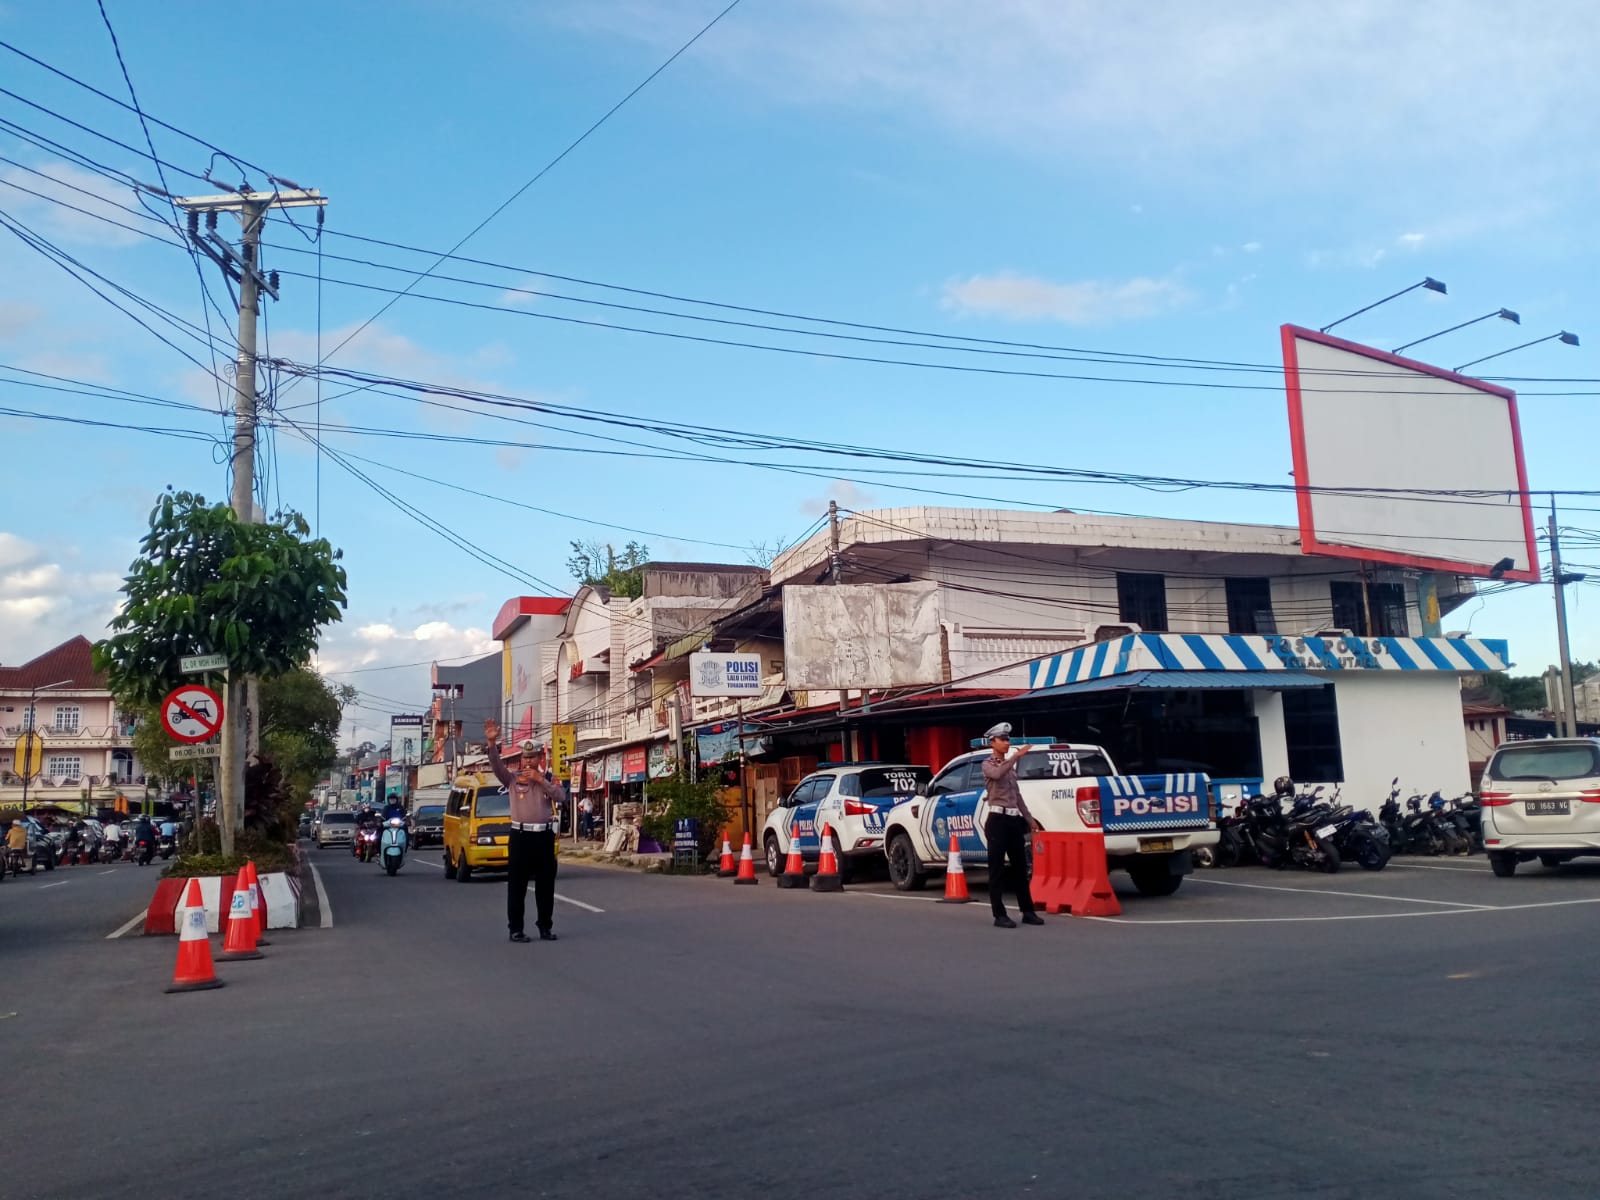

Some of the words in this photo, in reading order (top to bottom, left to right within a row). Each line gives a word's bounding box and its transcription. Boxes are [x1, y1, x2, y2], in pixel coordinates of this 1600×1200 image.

[1266, 638, 1306, 654] POS
[1324, 639, 1390, 655] POLISI
[726, 661, 759, 673] POLISI
[1047, 752, 1078, 760] TORUT
[1049, 759, 1081, 776] 701
[890, 778, 916, 791] 702
[1051, 788, 1075, 800] PATWAL
[1114, 795, 1199, 816] POLISI
[947, 815, 973, 830] POLISI
